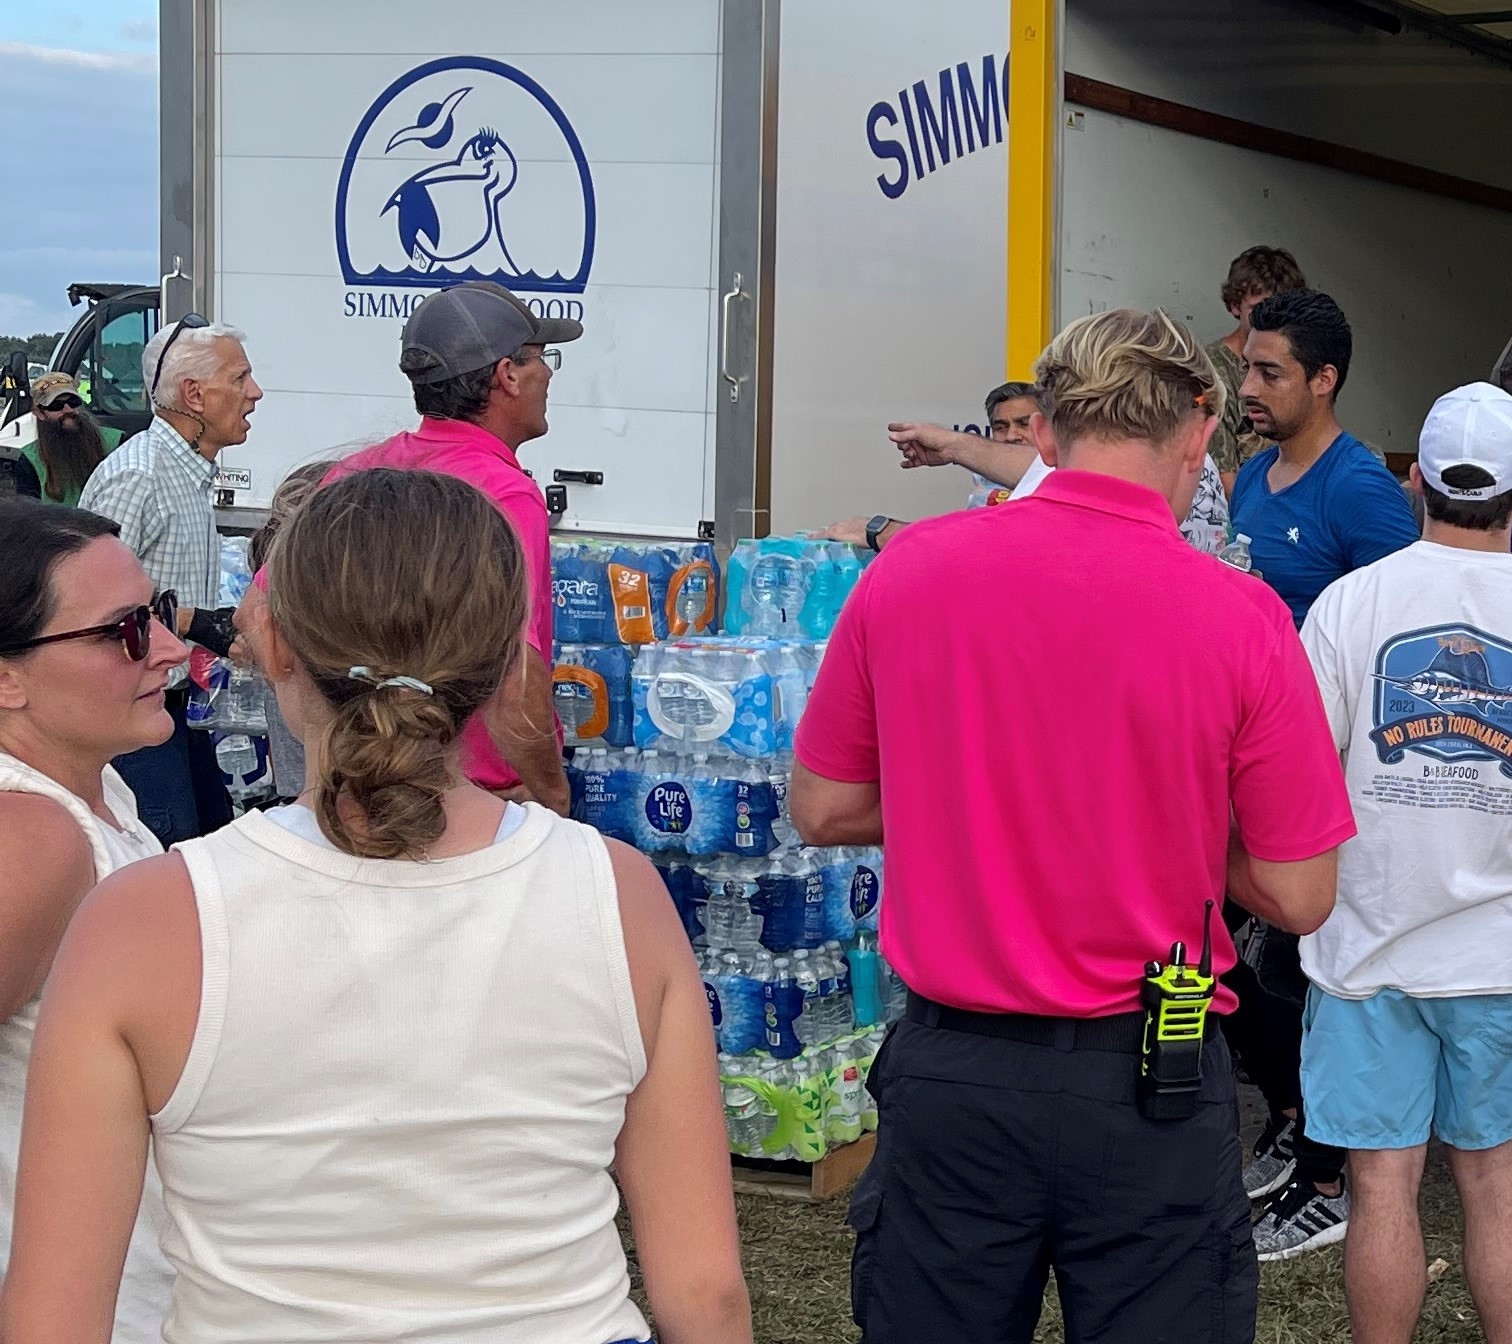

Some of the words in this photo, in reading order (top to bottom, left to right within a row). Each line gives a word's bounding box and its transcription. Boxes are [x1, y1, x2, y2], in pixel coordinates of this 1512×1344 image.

[865, 50, 1010, 199] SIMM
[617, 570, 641, 585] 32
[1389, 699, 1415, 713] 2023
[1383, 725, 1405, 747] NO
[1406, 715, 1444, 741] RULES
[654, 787, 686, 803] Pure
[659, 802, 684, 818] Life
